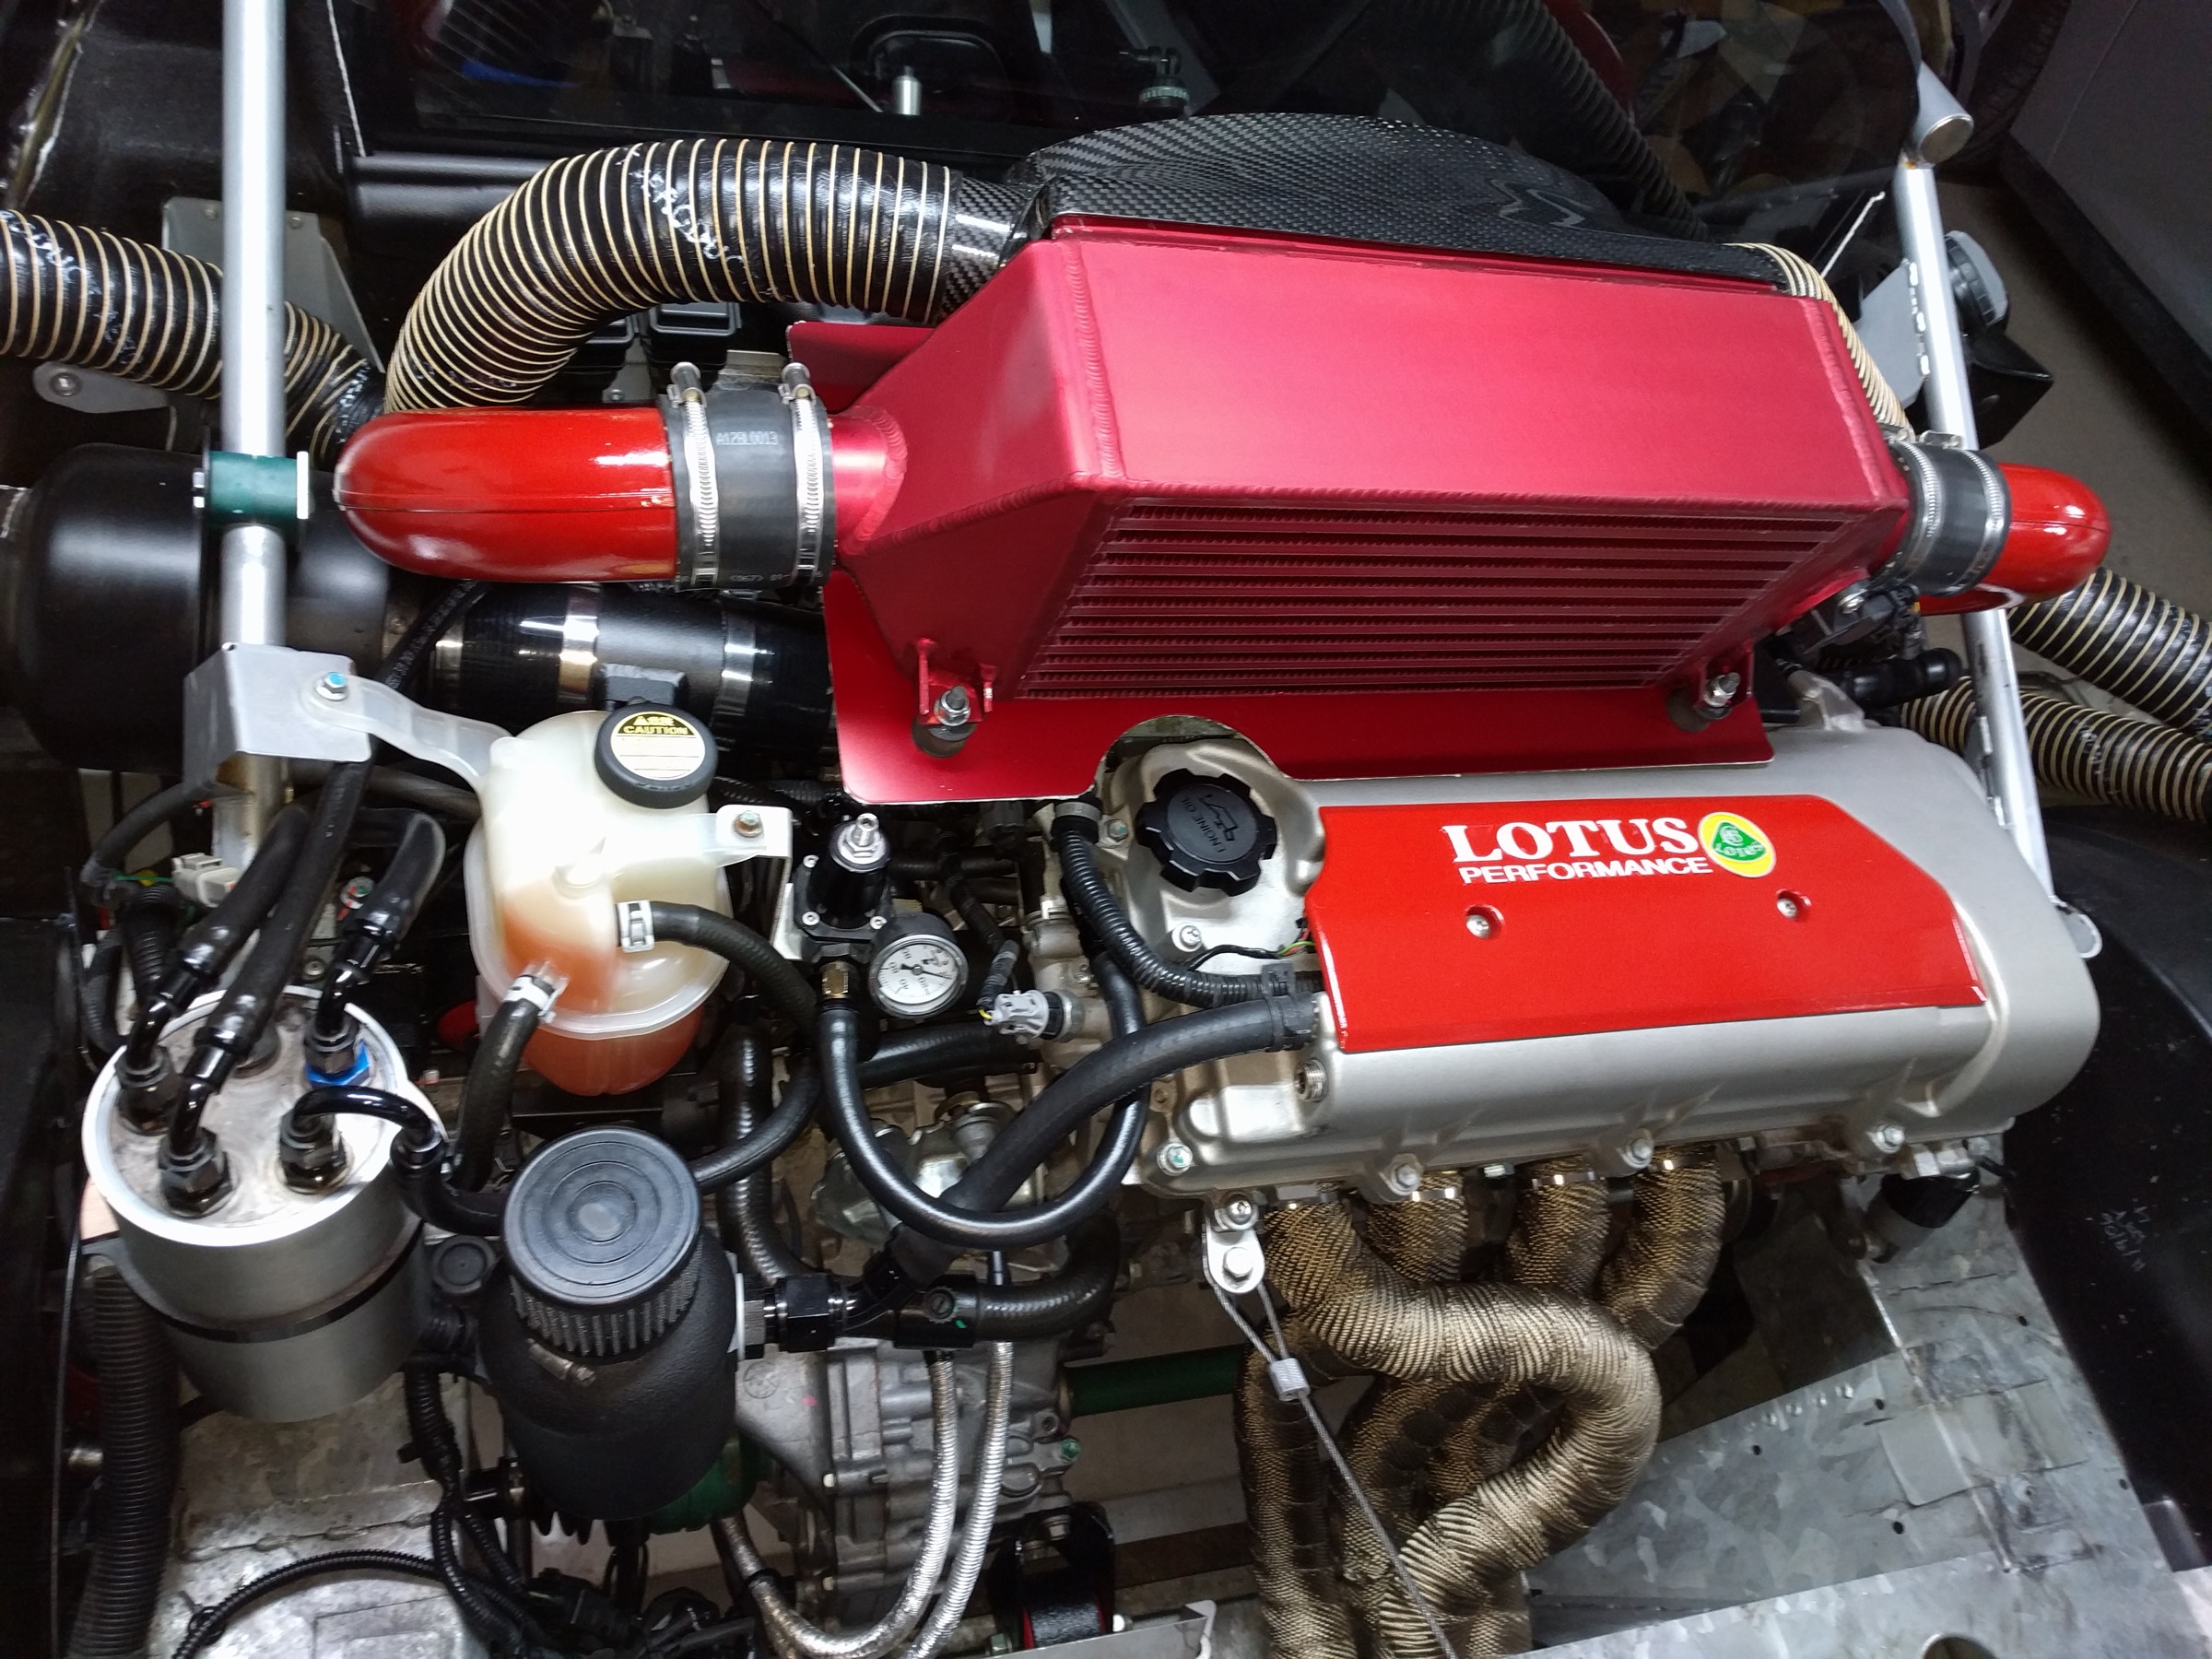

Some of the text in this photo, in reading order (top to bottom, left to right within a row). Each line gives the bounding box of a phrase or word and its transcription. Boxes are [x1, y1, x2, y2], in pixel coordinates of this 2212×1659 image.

[622, 724, 689, 735] CAUTION
[1181, 797, 1227, 853] ENGINE OIL
[1441, 817, 1700, 863] LOTUS
[1713, 841, 1767, 858] LOTUS
[1458, 856, 1714, 885] PERFORMANCE
